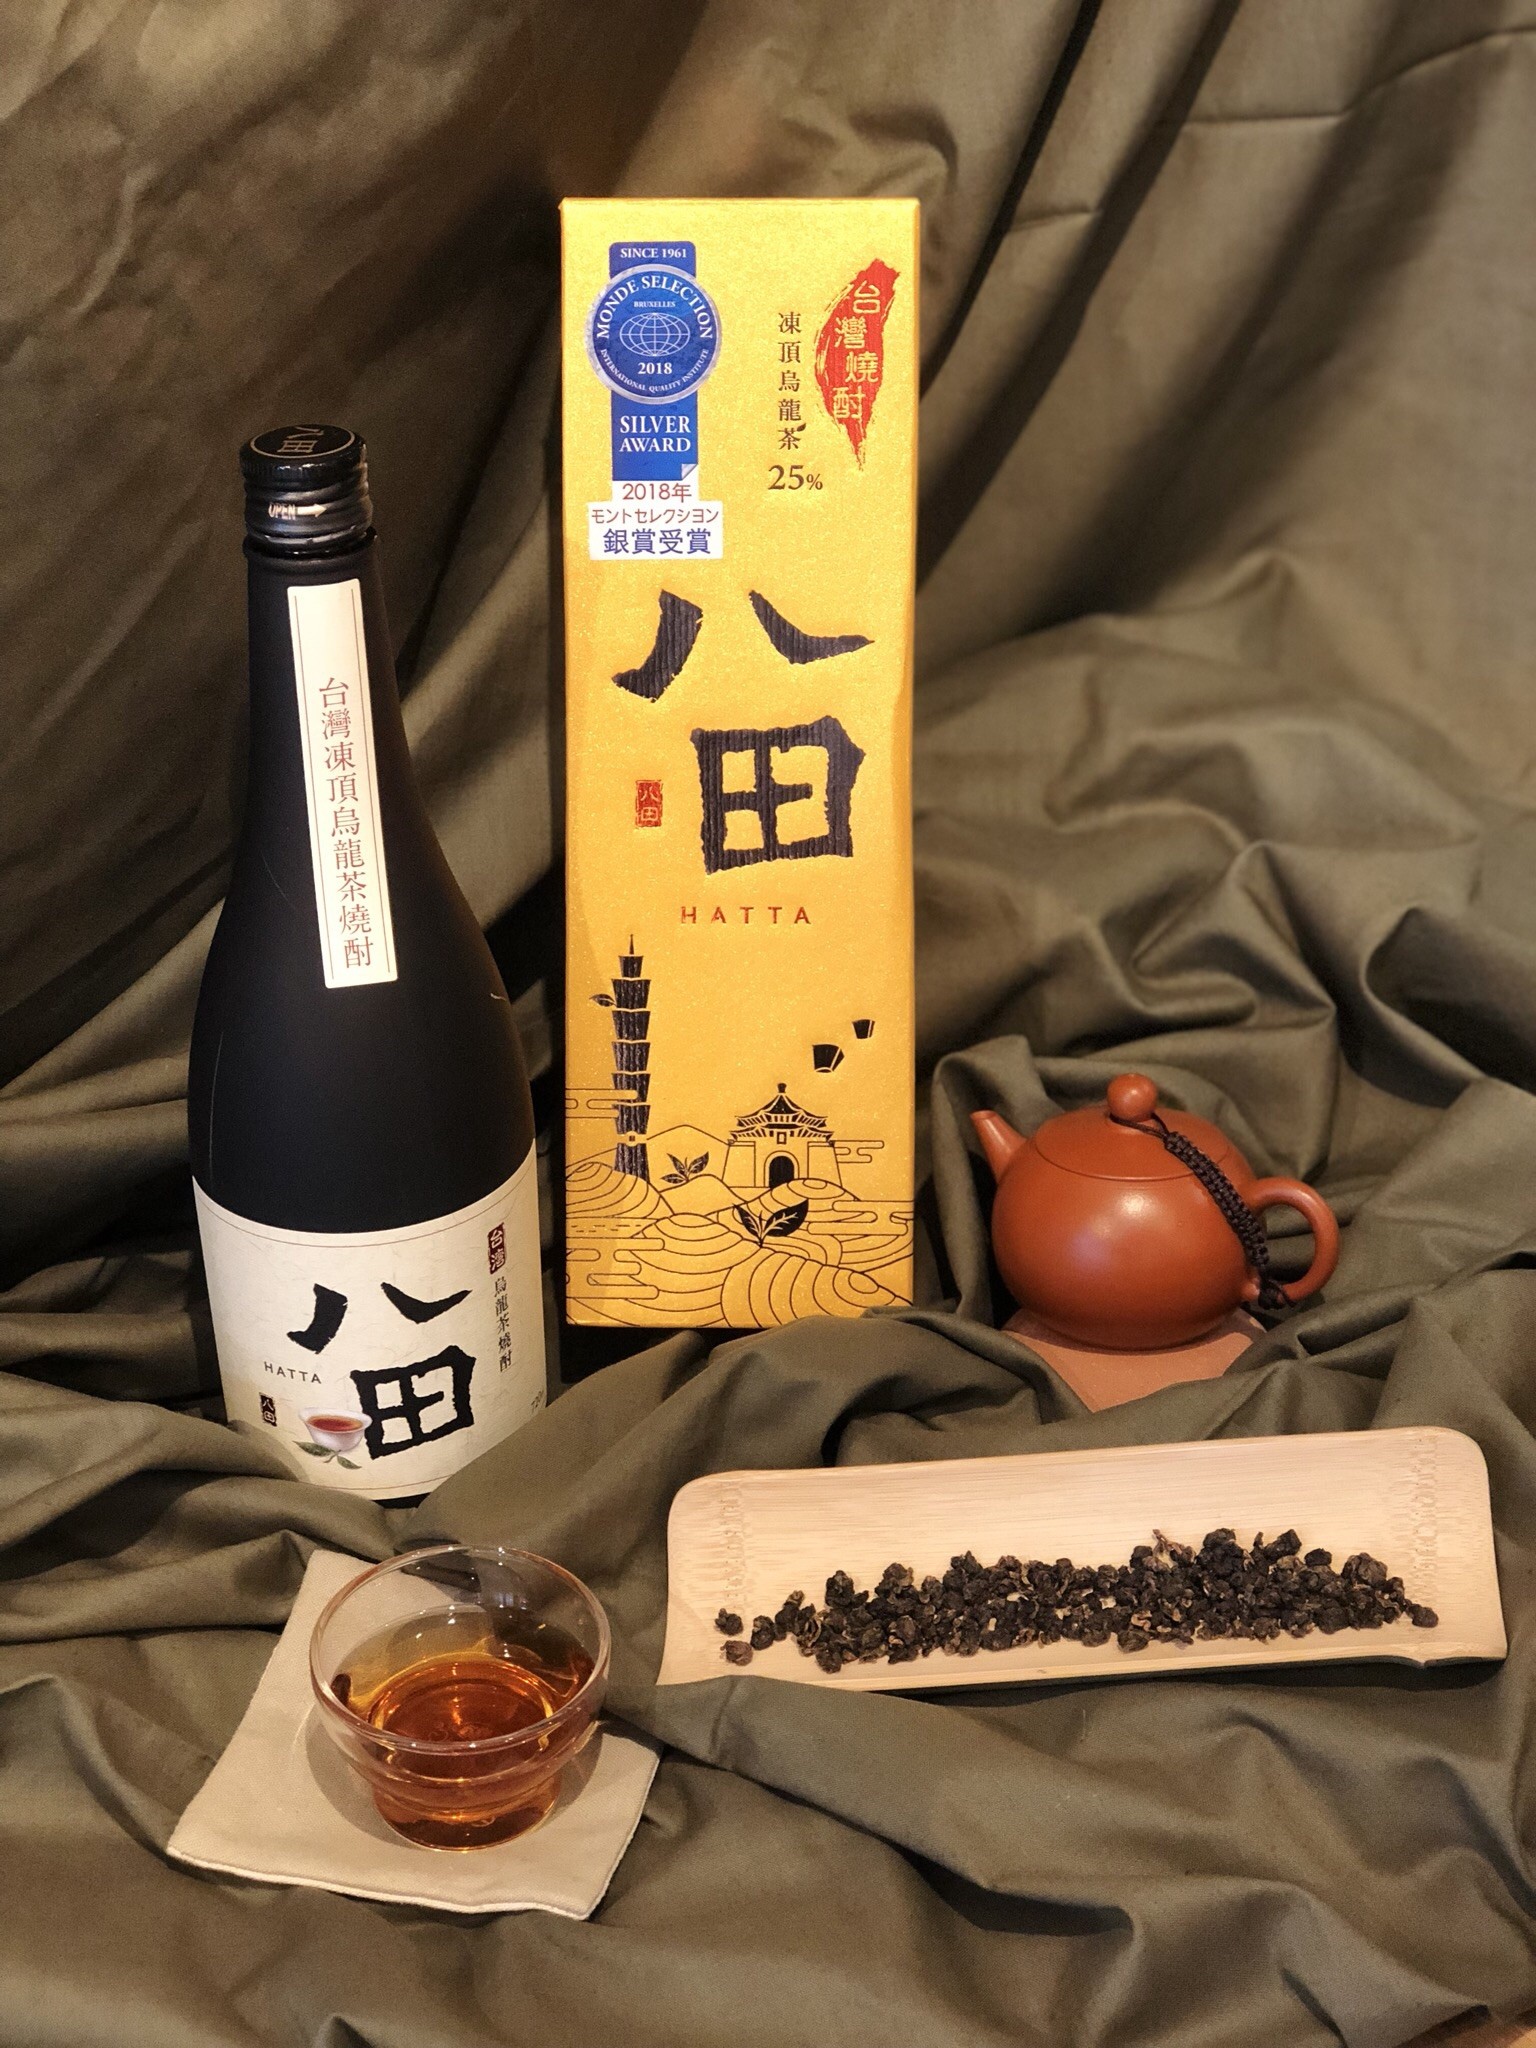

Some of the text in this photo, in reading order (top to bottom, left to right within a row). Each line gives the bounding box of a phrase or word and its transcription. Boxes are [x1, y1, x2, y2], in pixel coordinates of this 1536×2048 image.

[620, 247, 687, 259] SINCE 1961
[596, 275, 713, 340] MONDE SELECTION
[633, 300, 676, 308] BRUXELLES
[832, 279, 880, 420] 台灣燒酎
[600, 348, 710, 394] INTERNATIONAL QUALITY INSTITUTE
[638, 362, 673, 375] 2018
[778, 311, 804, 450] 凍頂烏龍茶
[619, 415, 691, 434] SILVER
[619, 437, 692, 453] AWARD
[767, 464, 824, 491] 25%
[622, 482, 692, 503] 2018年
[268, 502, 296, 520] OPEN
[603, 527, 711, 555] 銀賞受賞
[611, 588, 876, 875] 八田
[318, 676, 374, 969] 台灣凍頂烏龍茶燒酎
[681, 905, 812, 924] HATTA
[263, 1361, 322, 1384] HATTA
[286, 1281, 474, 1460] 八田
